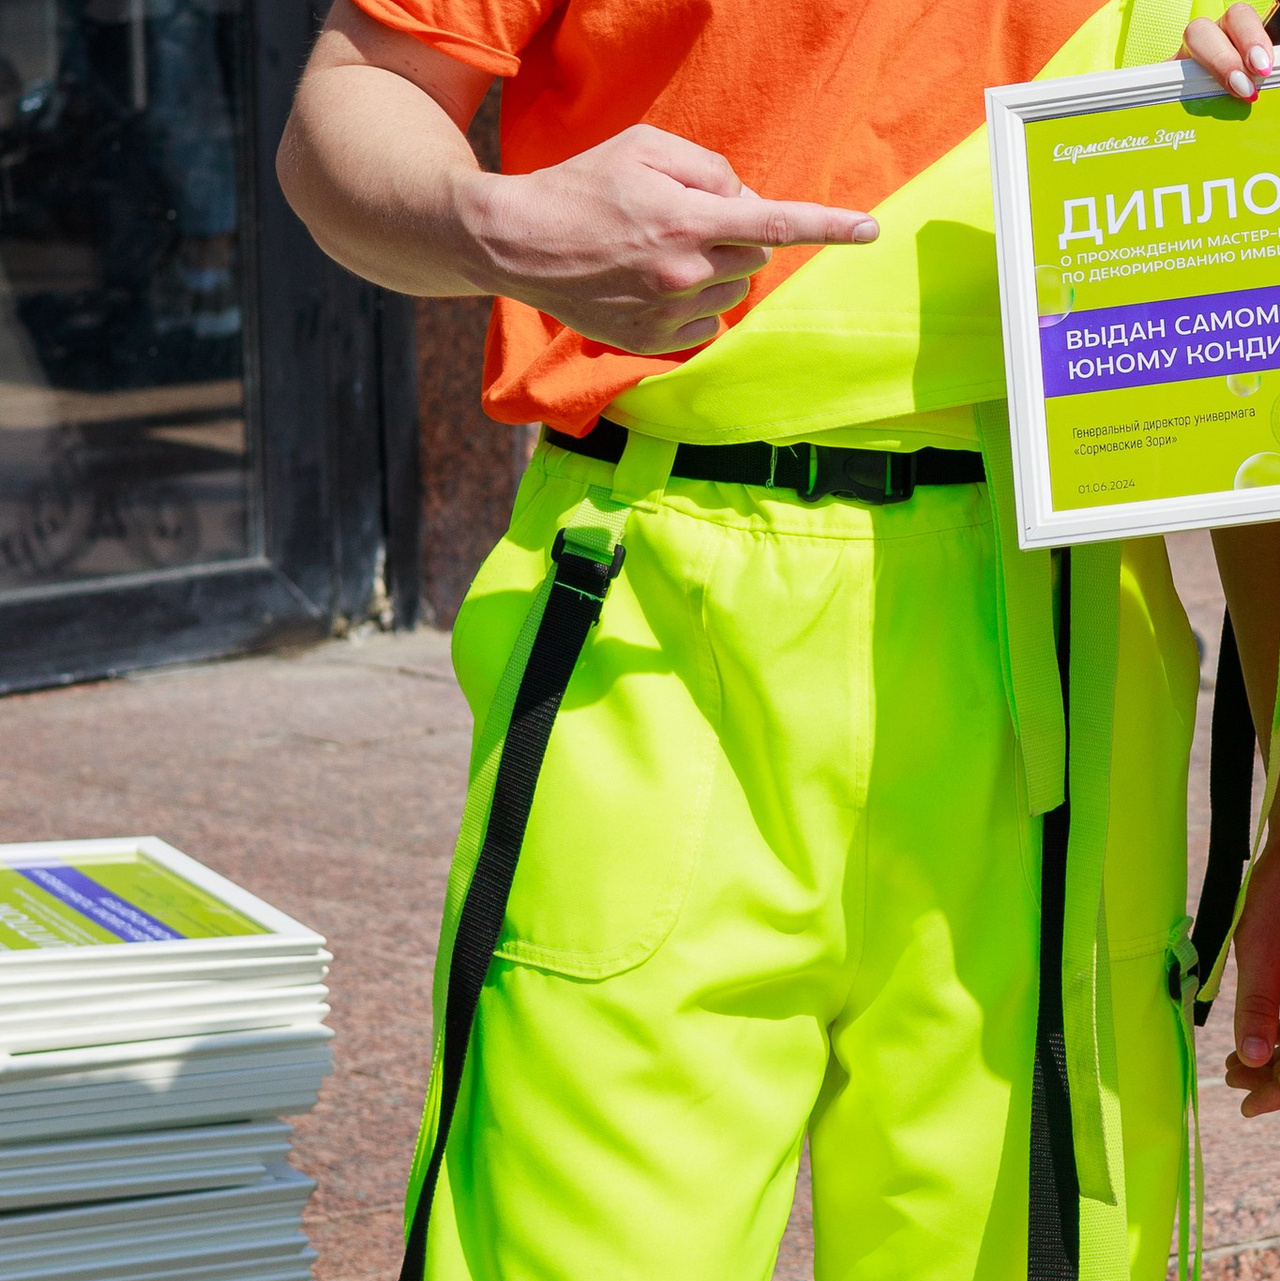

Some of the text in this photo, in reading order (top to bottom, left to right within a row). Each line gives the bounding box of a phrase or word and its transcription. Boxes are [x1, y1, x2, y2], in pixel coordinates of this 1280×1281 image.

[1053, 128, 1196, 164] Сормовские Зори
[1060, 255, 1073, 268] О
[1076, 238, 1203, 266] ПРОХОЖДЕНИИ
[1061, 270, 1085, 284] ПО
[1089, 250, 1236, 283] ДЕКОРИРОВАНИЮ
[1066, 318, 1166, 351] ВЫДАН
[1068, 347, 1178, 381] ЮНОМУ
[1072, 406, 1256, 439] Генеральный директор универмага
[1073, 433, 1178, 457] «Сормовские Зори»
[1077, 478, 1136, 495] 01.06.2024
